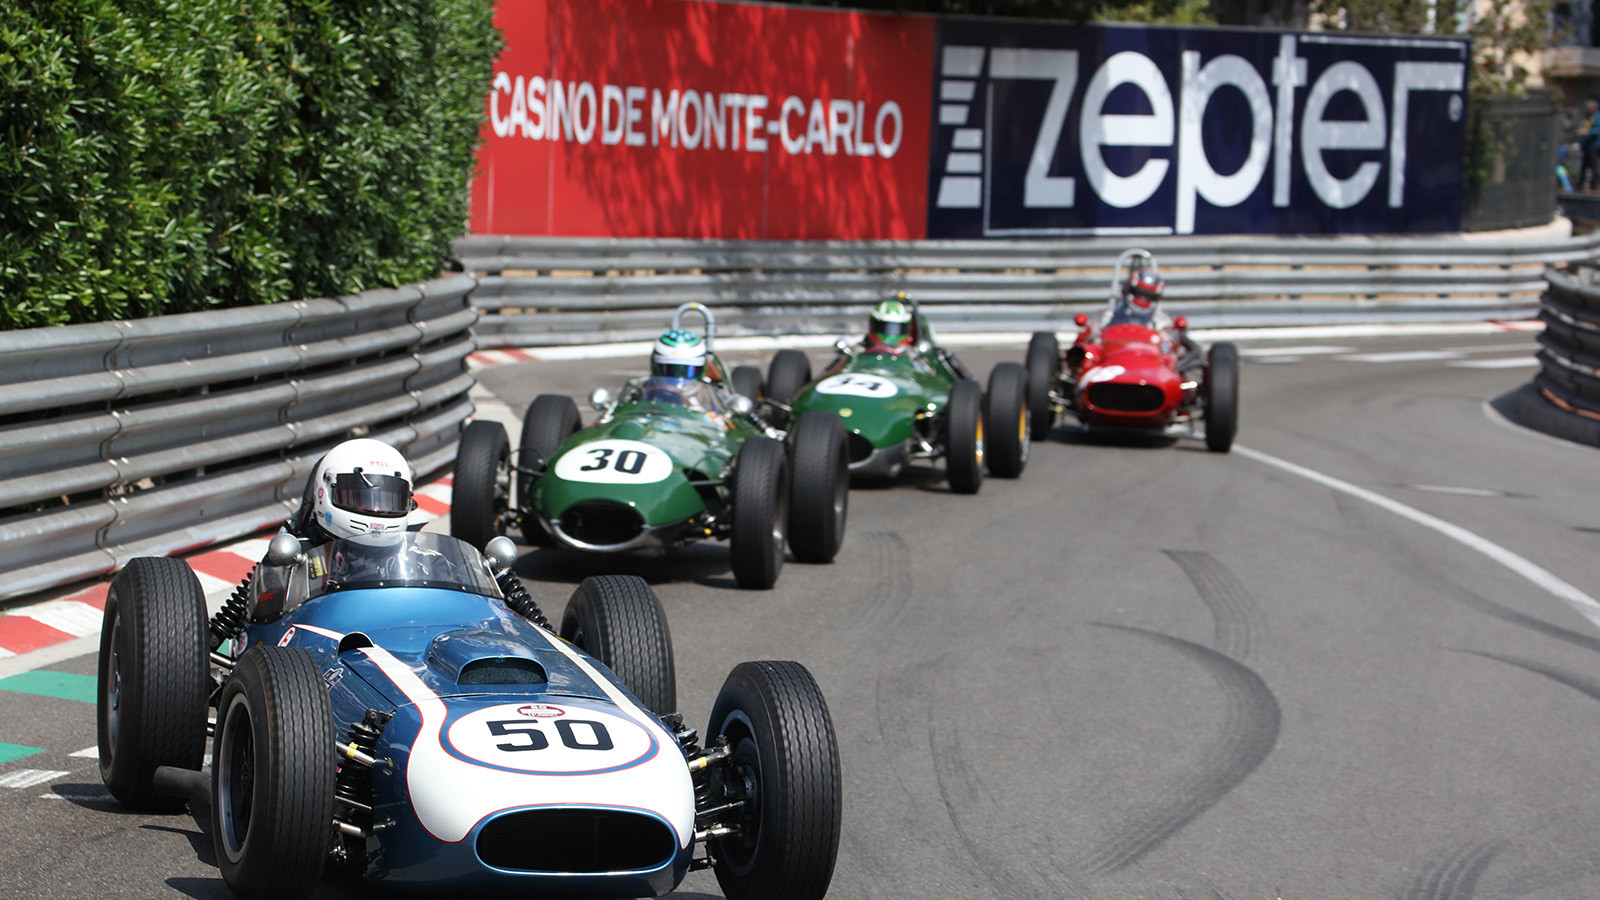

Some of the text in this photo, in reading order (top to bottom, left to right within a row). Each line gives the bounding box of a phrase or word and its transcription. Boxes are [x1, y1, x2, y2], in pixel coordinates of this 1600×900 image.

[490, 71, 903, 158] CASINO DE MONTE-CARLO
[989, 33, 1465, 235] zepter
[580, 448, 648, 475] 30
[485, 719, 615, 752] 50
